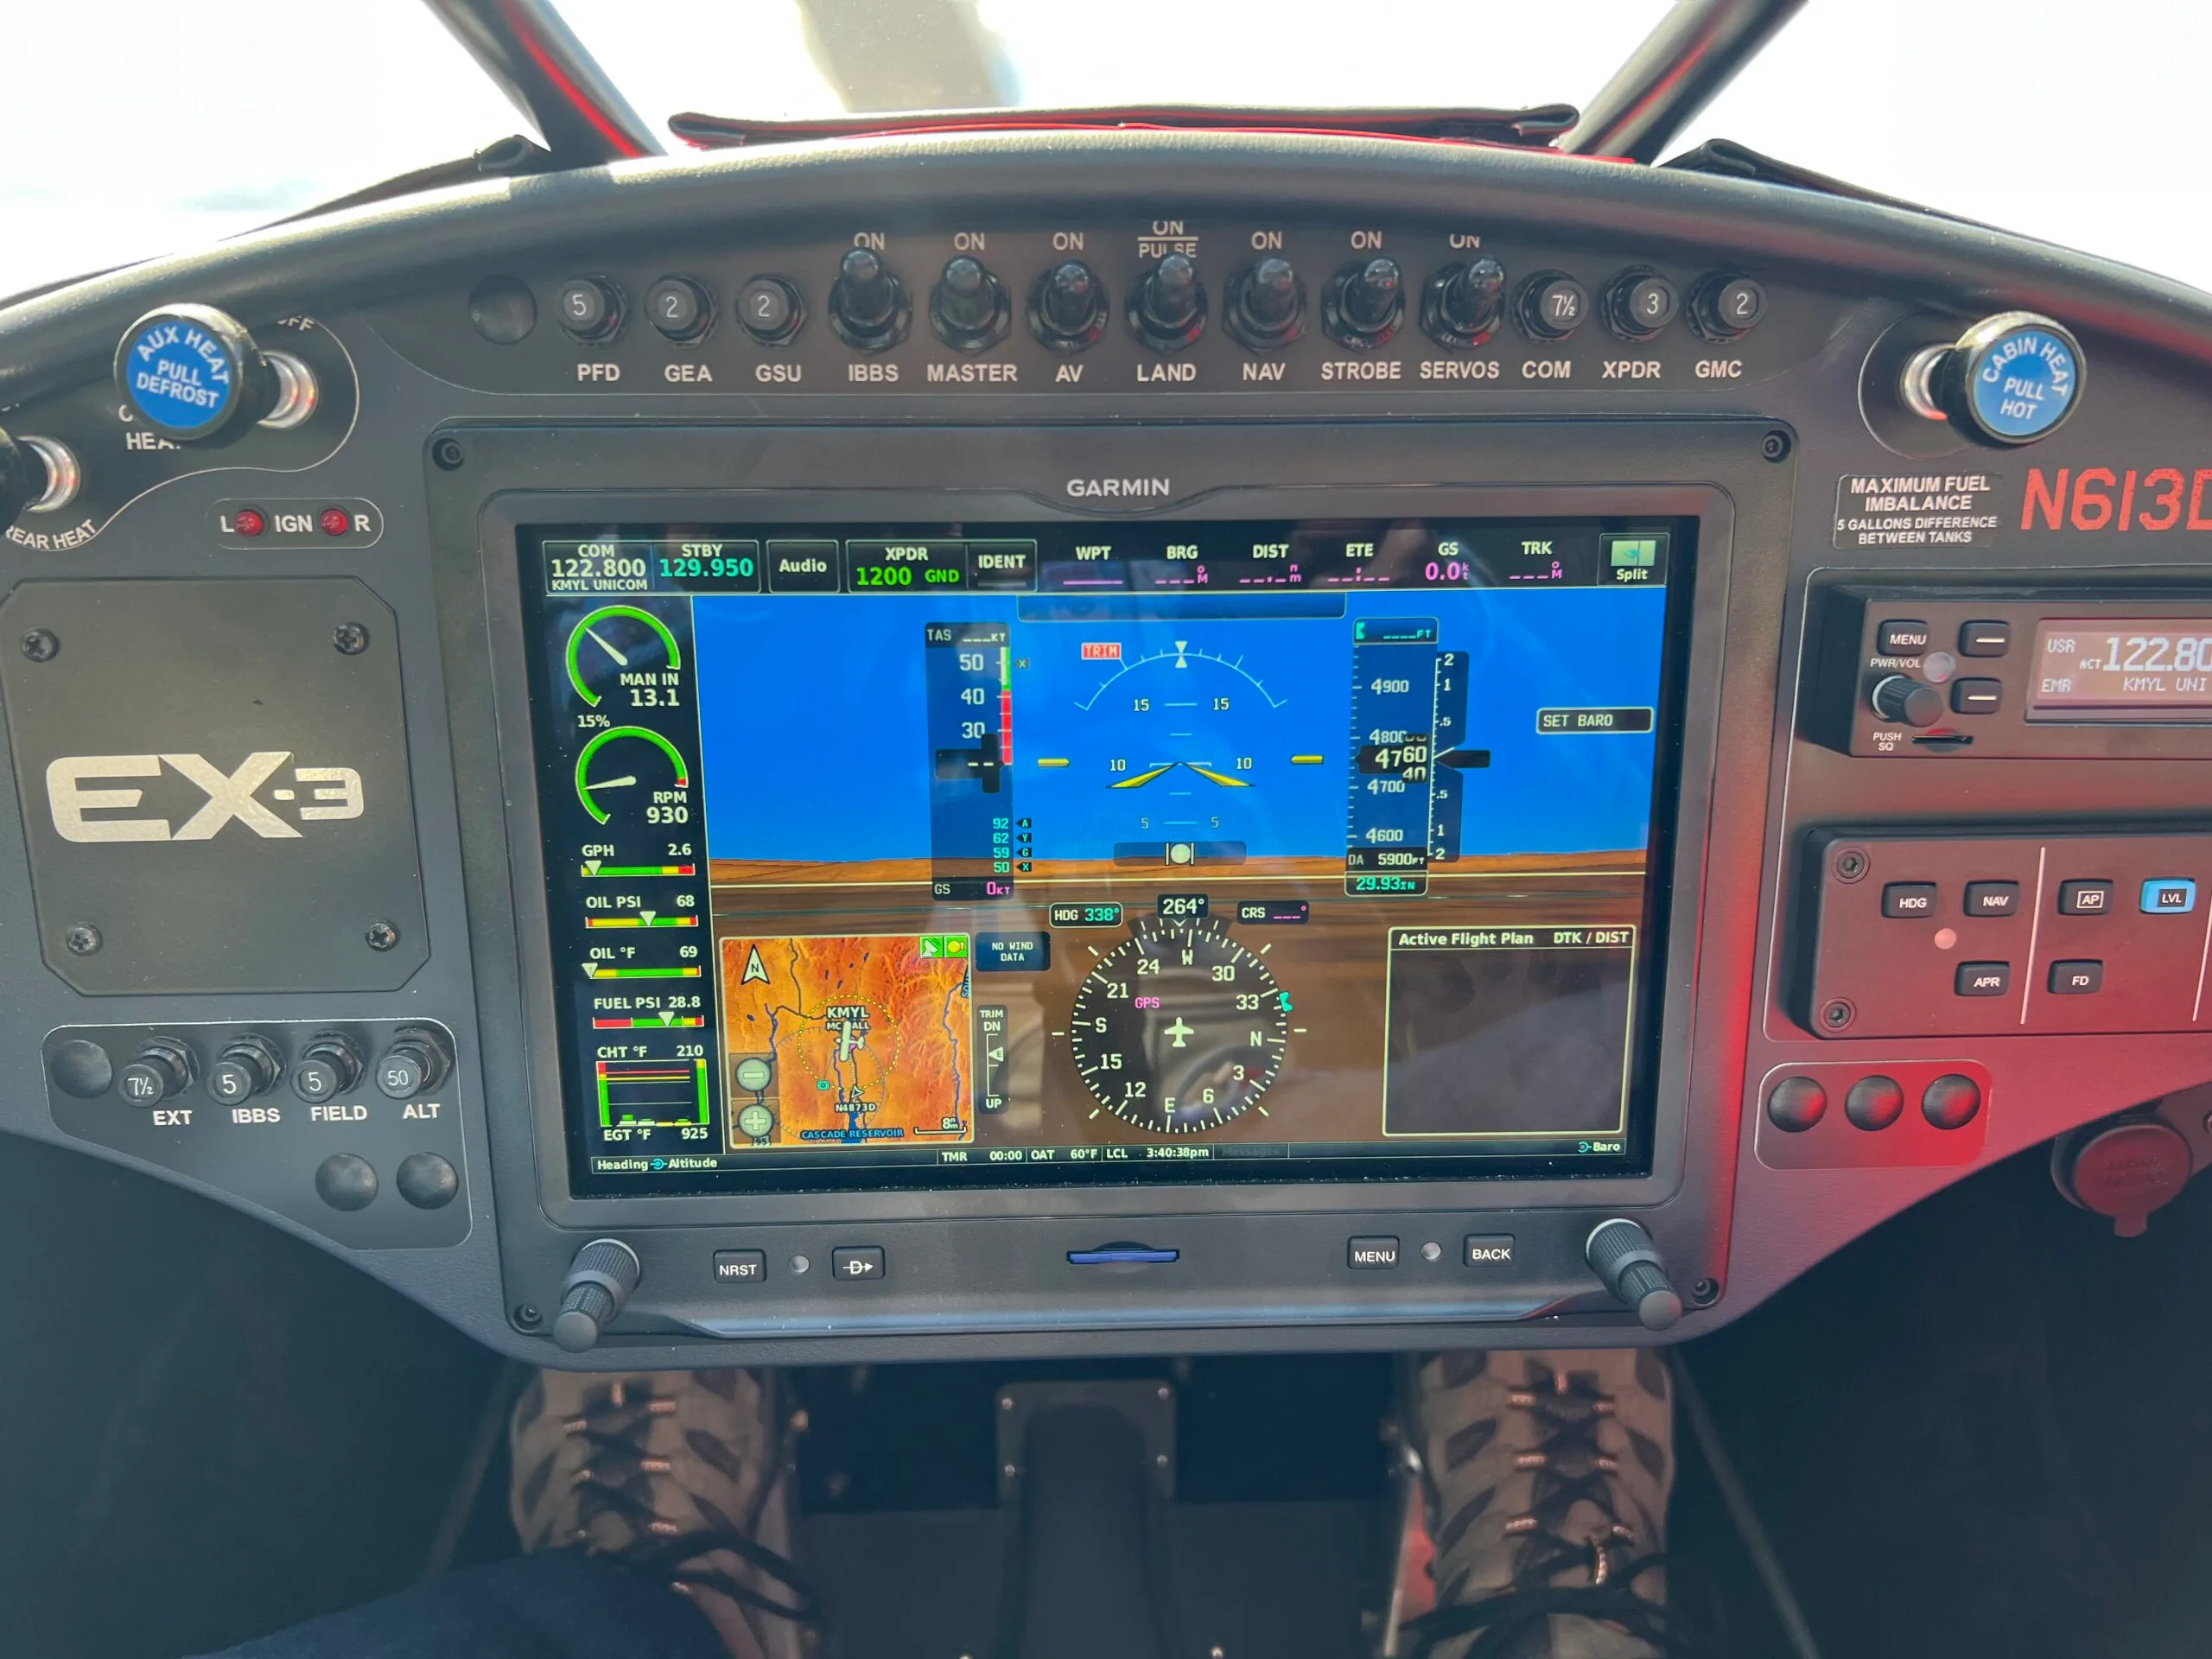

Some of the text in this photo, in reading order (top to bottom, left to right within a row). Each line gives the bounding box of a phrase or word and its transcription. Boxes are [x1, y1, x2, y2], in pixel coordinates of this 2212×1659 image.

[854, 232, 885, 251] ON
[954, 232, 985, 251] ON
[1052, 232, 1084, 251] ON
[1251, 232, 1282, 250] ON
[1351, 232, 1382, 250] ON
[573, 294, 587, 316] 5
[666, 296, 678, 318] 2
[758, 296, 770, 317] 2
[1646, 293, 1659, 315] 3
[1736, 293, 1749, 315] 2
[137, 326, 229, 385] AUX HEAT
[157, 359, 202, 387] PULL
[577, 364, 620, 382] PFD
[664, 365, 713, 382] GEA
[755, 365, 801, 382] GSU
[849, 365, 899, 382] IBBS
[927, 364, 1018, 382] MASTER
[1056, 365, 1084, 382] AV
[1137, 364, 1197, 382] LAND
[1243, 363, 1286, 381] NAV
[1321, 361, 1402, 380] STROBE
[1420, 361, 1500, 379] SERVOS
[1522, 360, 1571, 378] COM
[1602, 360, 1661, 379] XPDR
[1695, 359, 1743, 378] GMC
[1983, 336, 2069, 397] CABIN HEAT
[137, 372, 219, 410] DEFROST
[2004, 377, 2044, 402] PULL
[2000, 398, 2037, 420] HOT
[1066, 478, 1170, 498] GARMIN
[1851, 475, 1991, 493] MAXIMUM FUEL
[1865, 495, 1972, 512] IMBALANCE
[275, 515, 313, 532] IGN
[1837, 516, 1997, 531] 5 GALLONS DIFFERENCE
[52, 519, 96, 549] HEAT
[1858, 531, 1972, 545] BETWEEN TANKS
[578, 543, 614, 557] COM
[682, 543, 722, 557] STBY
[885, 547, 929, 562] XPDR
[1076, 545, 1111, 561] WPT
[1166, 544, 1198, 560] BRG
[1253, 543, 1288, 559] DIST
[1346, 543, 1374, 557] ETE
[1438, 542, 1459, 556] GS
[1522, 541, 1552, 555] TRK
[551, 558, 646, 577] 122.800
[659, 558, 753, 577] 129.950
[779, 558, 827, 574] Audio
[977, 555, 1026, 569] IDENT
[856, 567, 960, 587] 1200 GND
[1616, 569, 1649, 582] Split
[551, 578, 647, 591] KMYL UNICOM
[926, 629, 951, 641] TAS
[1890, 633, 1926, 646] MENU
[1084, 645, 1118, 658] TRIM
[2047, 639, 2075, 653] USR
[2080, 637, 2212, 672] ACT 122.80
[1870, 658, 1921, 670] PWR/VOL
[620, 672, 679, 686] MAN IN
[2042, 679, 2071, 693] EMR
[2123, 677, 2208, 692] KMYL UNI
[630, 689, 680, 707] 13.1
[577, 715, 610, 728] 15%
[1543, 714, 1613, 728] SET BARO
[1872, 732, 1902, 742] PUSH
[1878, 742, 1893, 752] SQ
[47, 752, 364, 843] EX-3
[653, 791, 687, 804] RPM
[646, 806, 689, 824] 930
[582, 844, 614, 857] GPH
[668, 843, 692, 856] 2.6
[586, 895, 640, 908] OIL PSI
[677, 894, 695, 907] 68
[1899, 898, 1926, 909] HDG
[1983, 895, 2009, 907] NAV
[2082, 893, 2099, 906] AP
[2162, 893, 2182, 905] LVL
[1162, 898, 1205, 915] 264°
[1241, 906, 1266, 919] CRS
[1054, 907, 1120, 922] HDG 338°
[1399, 932, 1534, 948] Active Flight Plan
[1553, 931, 1630, 944] DTK DIST
[589, 946, 636, 959] OIL °F
[679, 945, 698, 958] 69
[992, 941, 1033, 951] NO WIND
[1000, 953, 1025, 962] DATA
[1974, 976, 1999, 988] APR
[2072, 976, 2088, 987] FD
[594, 996, 660, 1009] FUEL PSI
[668, 995, 701, 1009] 28.8
[1135, 997, 1160, 1009] GPS
[827, 1007, 869, 1019] KMYL
[980, 1009, 1003, 1019] TRIM
[983, 1021, 1001, 1032] DN
[597, 1046, 647, 1058] CHT °F
[677, 1045, 704, 1058] 210
[223, 1074, 237, 1095] 5
[308, 1071, 322, 1092] 5
[388, 1070, 409, 1087] 50
[985, 1098, 1002, 1109] UP
[153, 1109, 193, 1126] EXT
[232, 1108, 281, 1123] IBBS
[311, 1105, 368, 1122] FIELD
[403, 1103, 441, 1120] ALT
[603, 1128, 652, 1141] EGT °F
[681, 1128, 709, 1141] 925
[801, 1128, 904, 1140] CASCADE RESERVOIR
[1031, 1148, 1097, 1160] OAT 60°F
[1106, 1148, 1128, 1160] LCL
[1147, 1147, 1209, 1160] 3:40:38pm
[1592, 1141, 1621, 1153] Baro
[668, 1157, 718, 1169] Altitude
[942, 1150, 1022, 1162] TMR 00:00
[597, 1160, 648, 1172] Heading
[1354, 1249, 1395, 1262] MENU
[1472, 1248, 1511, 1261] BACK
[719, 1264, 757, 1276] NRST
